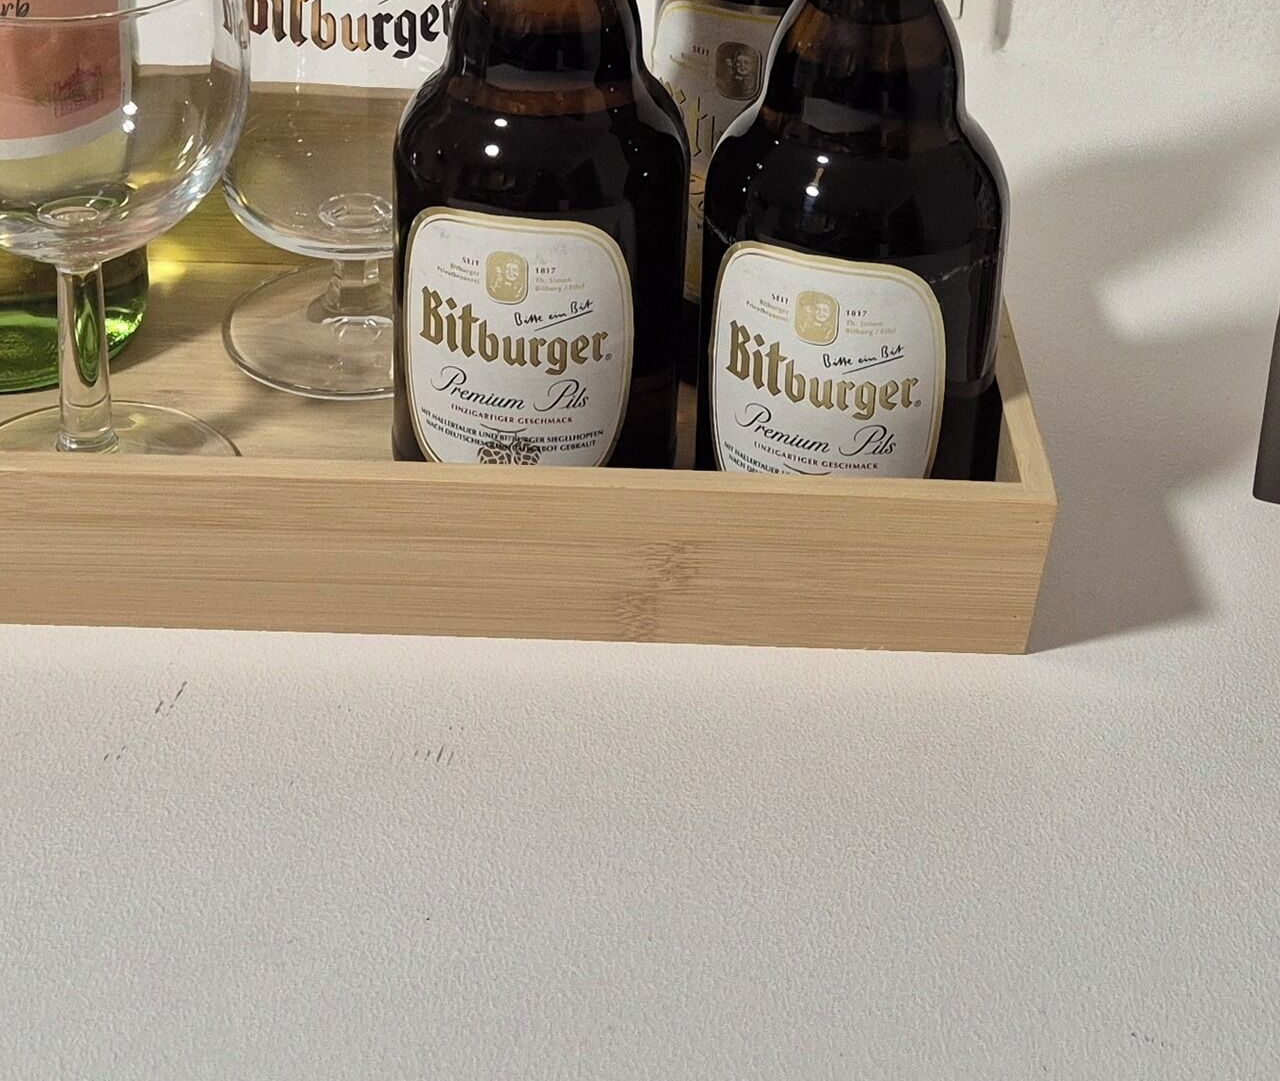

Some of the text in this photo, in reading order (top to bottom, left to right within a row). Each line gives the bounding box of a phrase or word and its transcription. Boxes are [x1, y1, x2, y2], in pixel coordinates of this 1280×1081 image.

[514, 311, 542, 327] Bitte
[570, 299, 594, 314] Bit
[823, 353, 851, 369] Bitte
[881, 344, 904, 358] Bit
[430, 366, 589, 412] Premium Pils
[451, 403, 573, 425] EINZIGARTIGER GESCHMACK
[734, 403, 897, 456] Premium Pils
[753, 441, 879, 470] EINZIGARTIGER GESCHMACK
